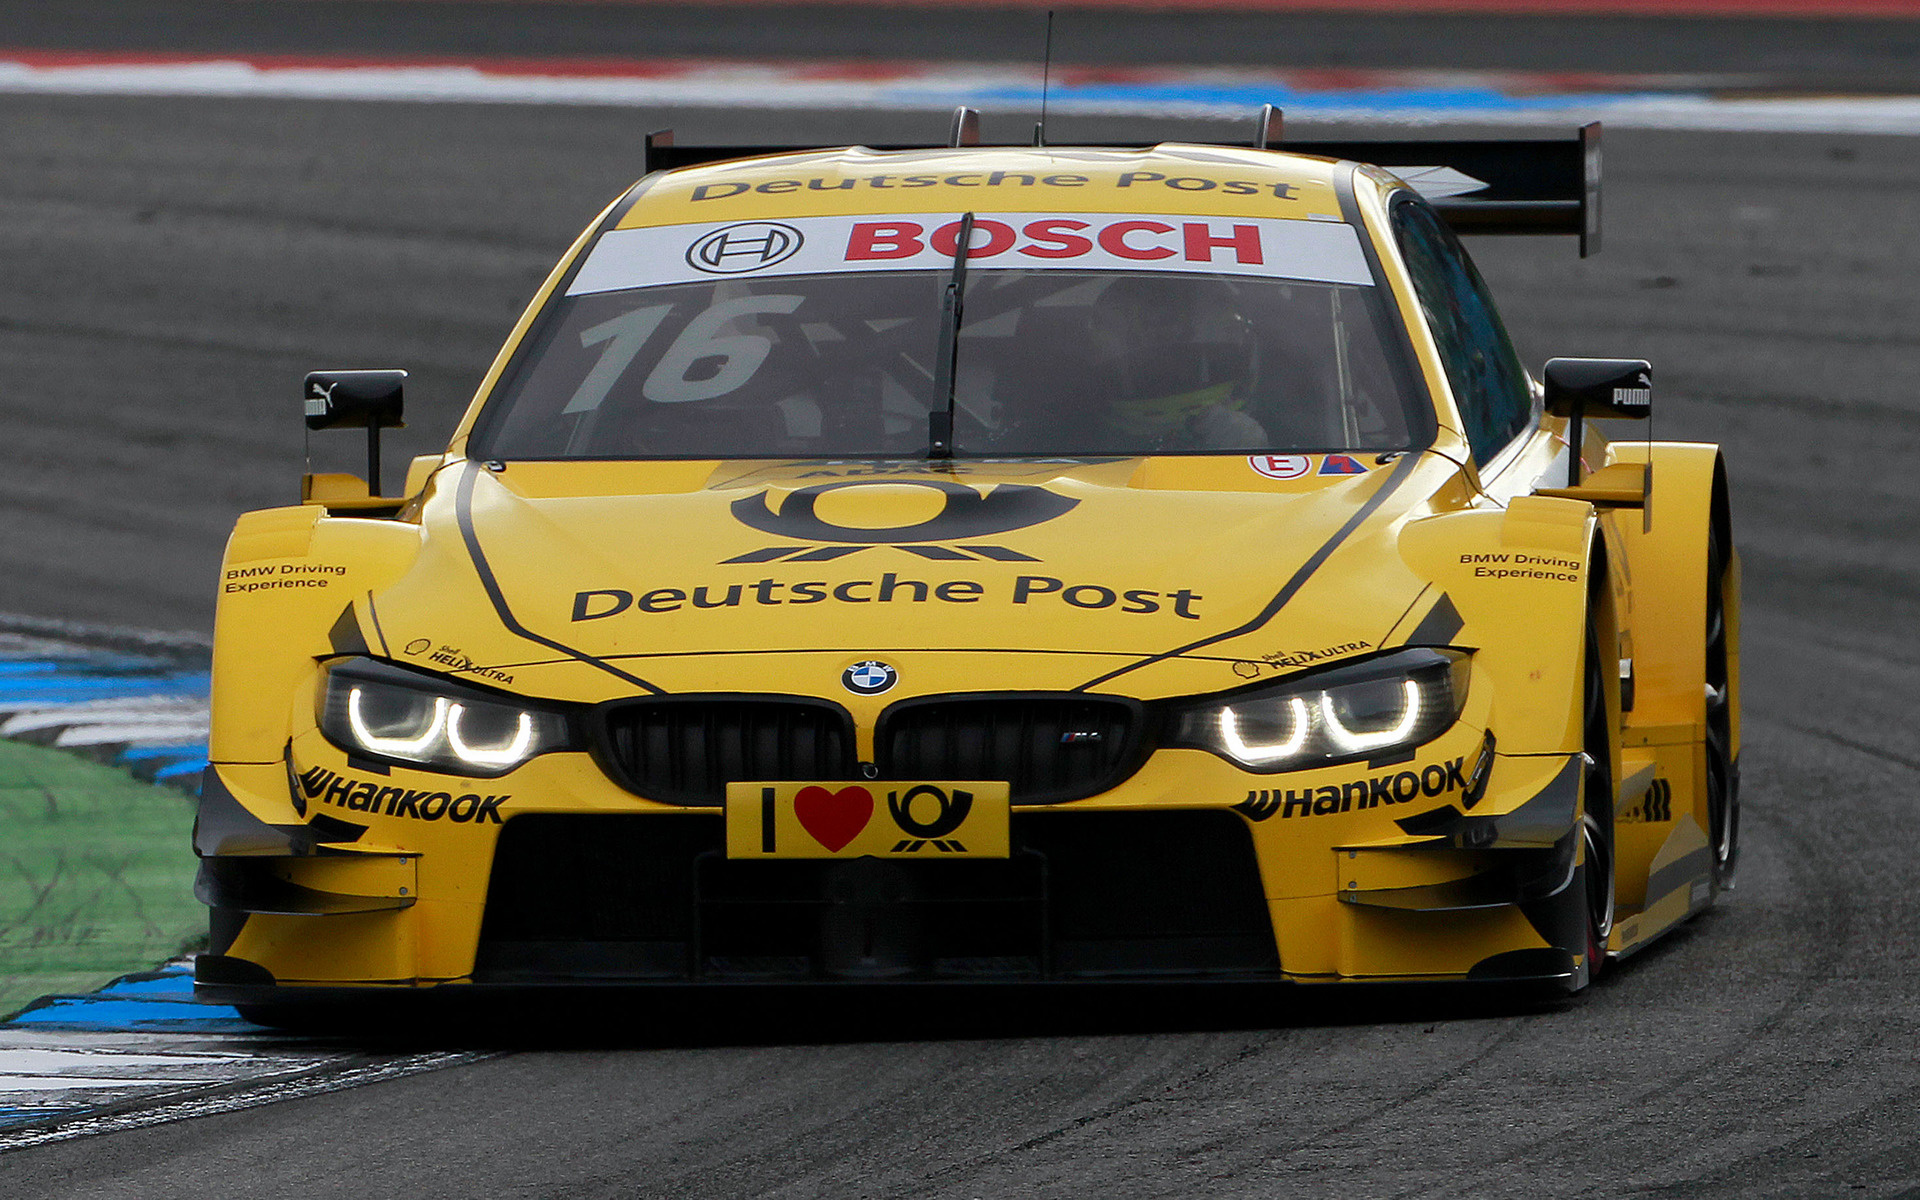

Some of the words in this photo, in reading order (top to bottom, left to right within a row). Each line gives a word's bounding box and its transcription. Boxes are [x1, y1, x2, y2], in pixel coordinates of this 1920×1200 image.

[690, 170, 1090, 202] Deutsche
[1117, 171, 1300, 201] Post
[844, 219, 1264, 265] BOSCH
[561, 294, 807, 415] 16
[1460, 554, 1510, 564] BMW
[1514, 554, 1580, 571] Driving
[226, 566, 276, 580] BMW
[281, 564, 346, 576] Driving
[1474, 567, 1578, 583] Experience
[225, 579, 329, 593] Experience
[570, 572, 986, 622] Deutsche
[1011, 575, 1204, 620] Post
[1320, 640, 1372, 657] ULTRA
[847, 660, 895, 672] BMW
[761, 786, 776, 854] I
